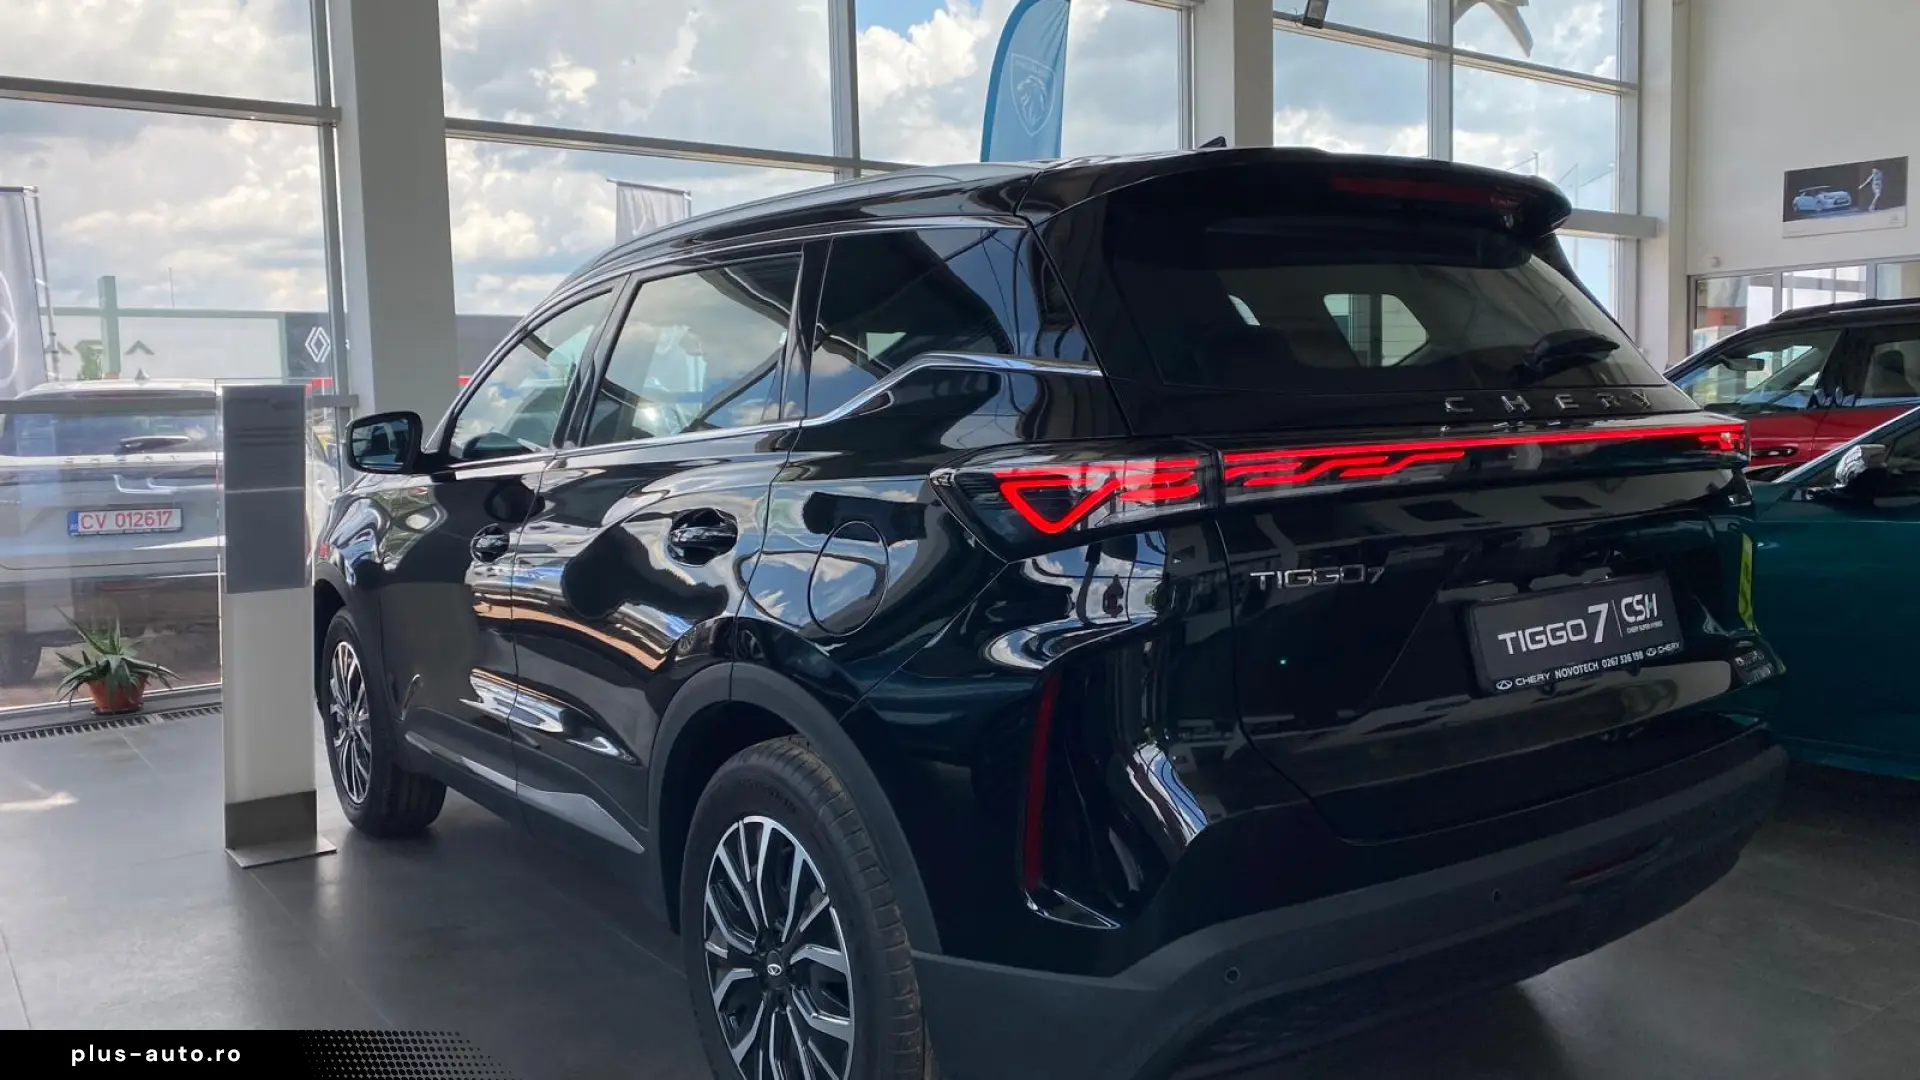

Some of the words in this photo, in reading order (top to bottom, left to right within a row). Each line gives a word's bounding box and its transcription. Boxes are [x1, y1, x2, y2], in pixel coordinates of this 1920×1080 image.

[1444, 388, 1651, 413] CHERY
[81, 512, 107, 529] CV
[115, 510, 173, 528] 012617
[1621, 593, 1657, 623] CSH
[1497, 619, 1588, 655] TIGGO
[1588, 603, 1608, 643] 7
[1515, 672, 1550, 686] CHERY
[1554, 661, 1599, 679] NOVOTECH
